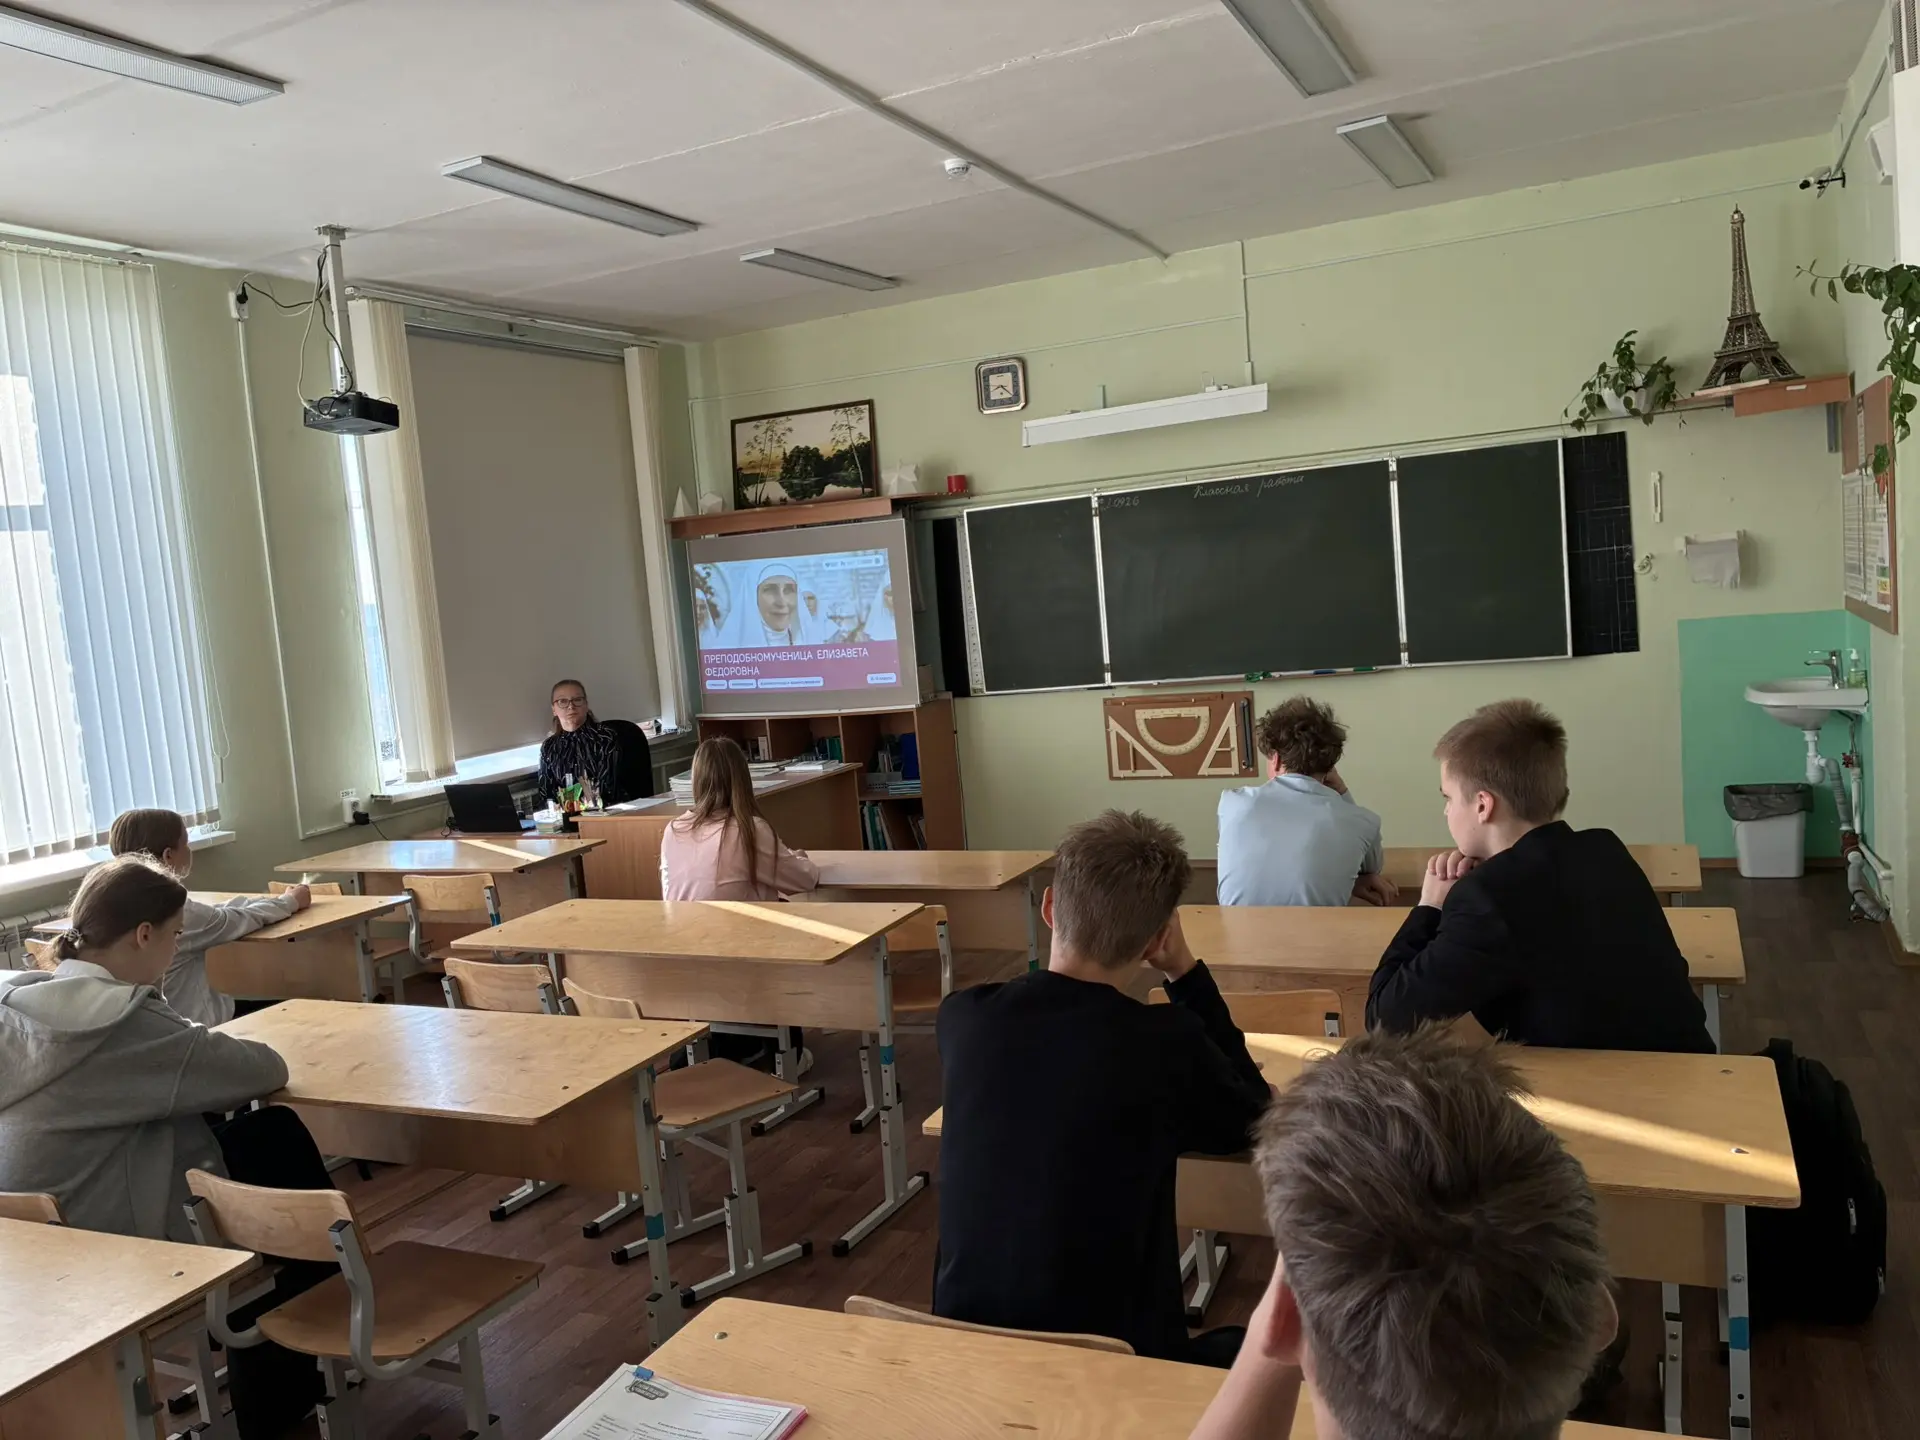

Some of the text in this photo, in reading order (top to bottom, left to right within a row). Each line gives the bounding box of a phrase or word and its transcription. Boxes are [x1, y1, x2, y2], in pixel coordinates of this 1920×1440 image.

[704, 647, 869, 665] ПРЕПОДОБНОМУЧЕНИЦА ЕЛИЗАВЕТА
[704, 666, 760, 677] ФЕДОРОВНА
